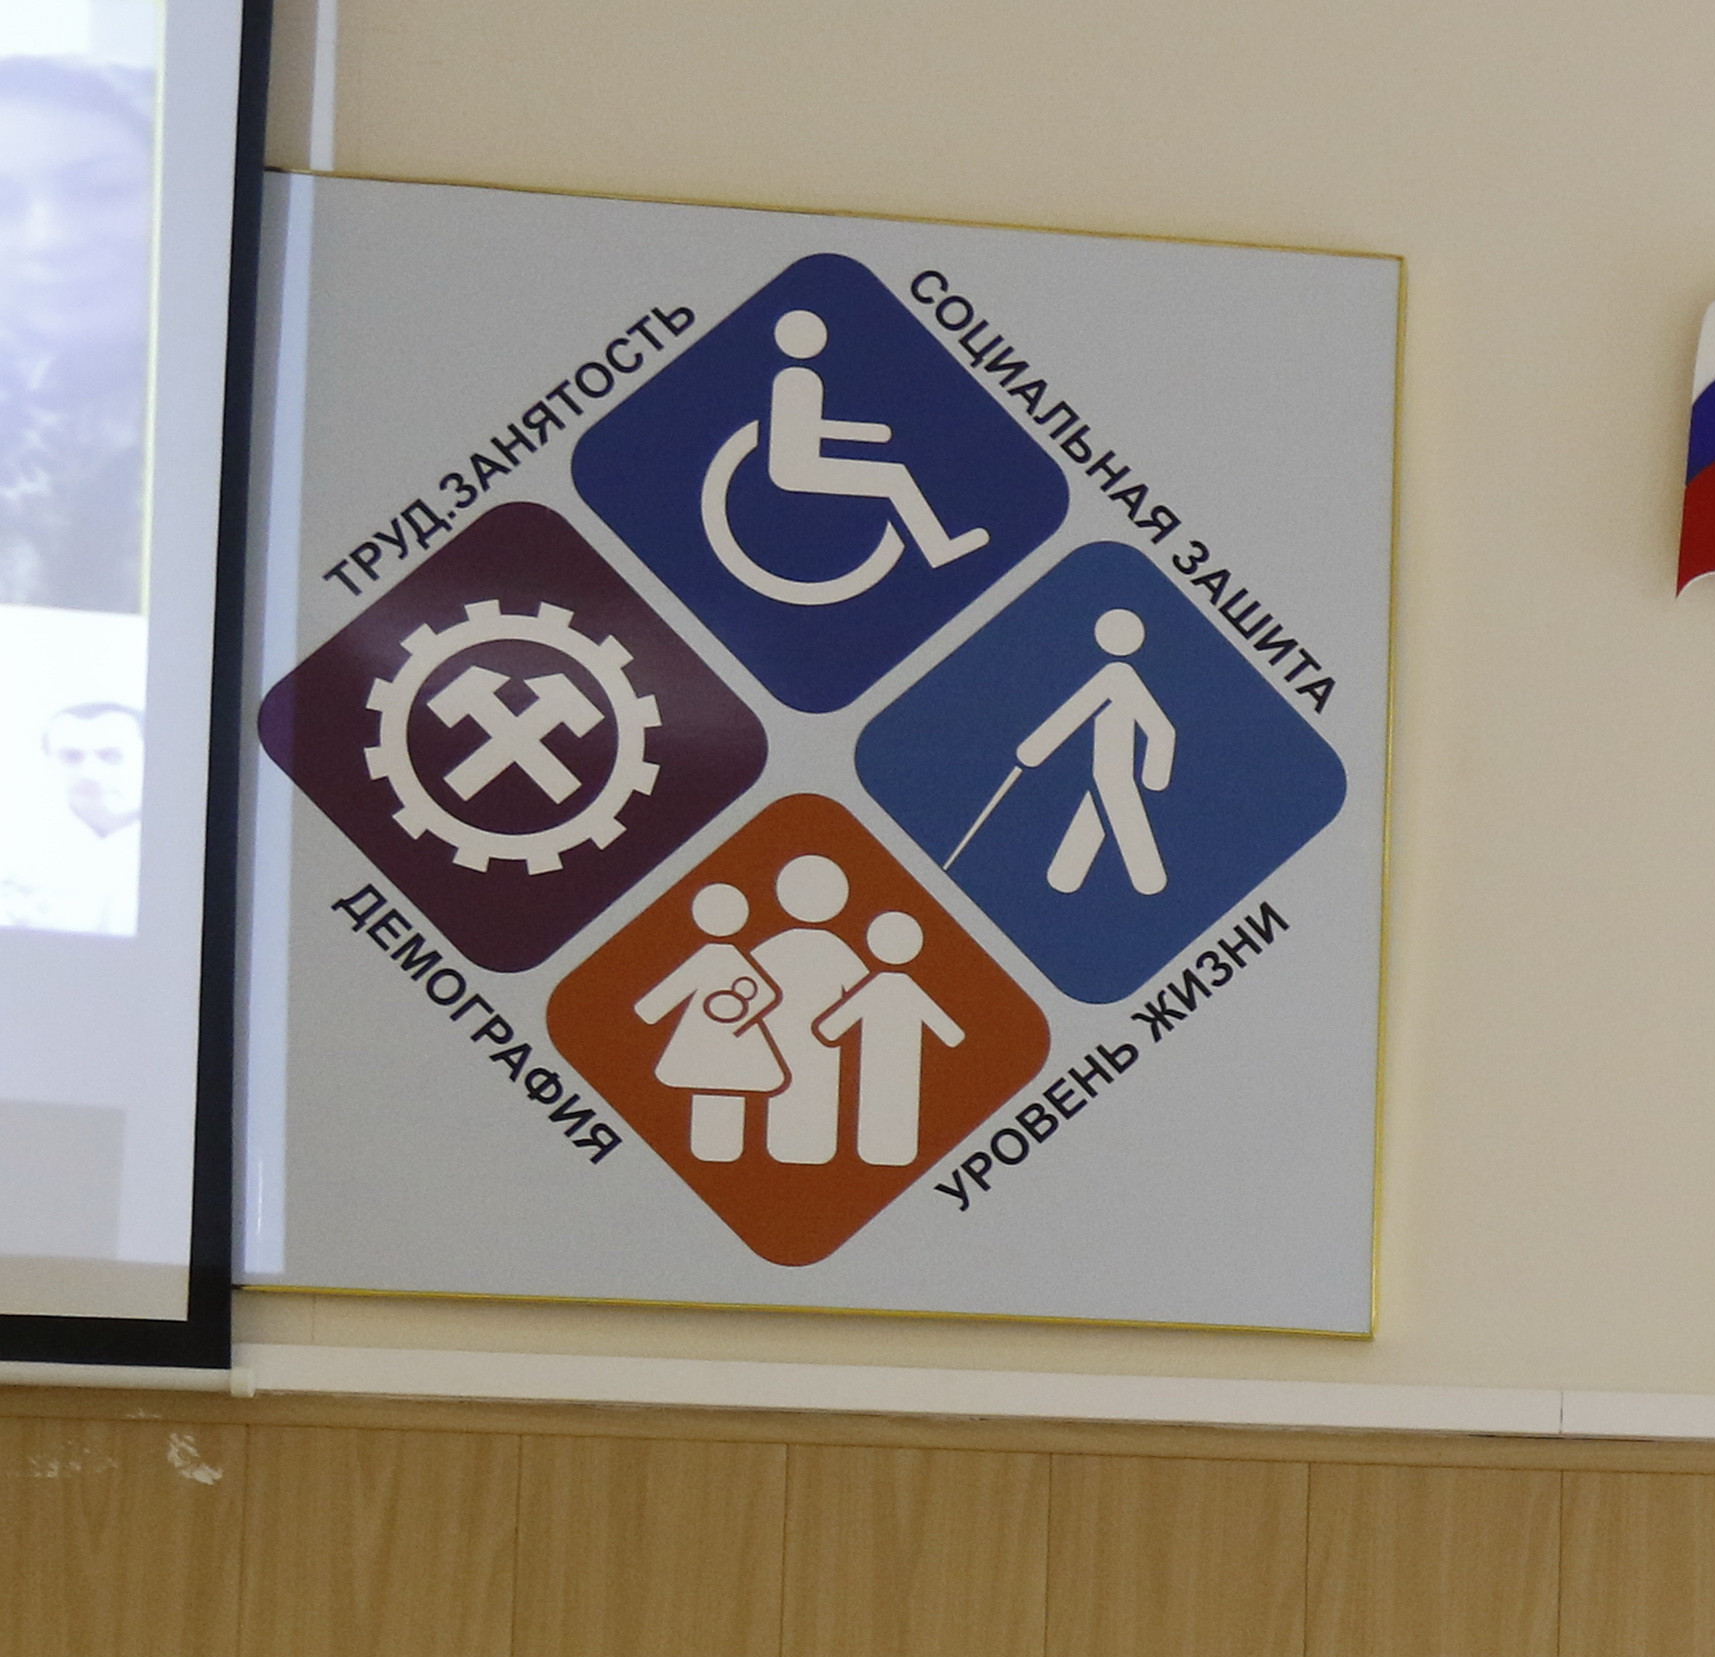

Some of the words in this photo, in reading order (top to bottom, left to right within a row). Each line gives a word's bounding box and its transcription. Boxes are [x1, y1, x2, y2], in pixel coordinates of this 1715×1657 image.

[907, 269, 1182, 545] СОЦИАЛЬНАЯ
[330, 884, 623, 1167] ДЕМОГРАФИЯ
[933, 1041, 1139, 1212] УРОВЕНЬ
[1129, 901, 1290, 1043] ЖИЗНИ
